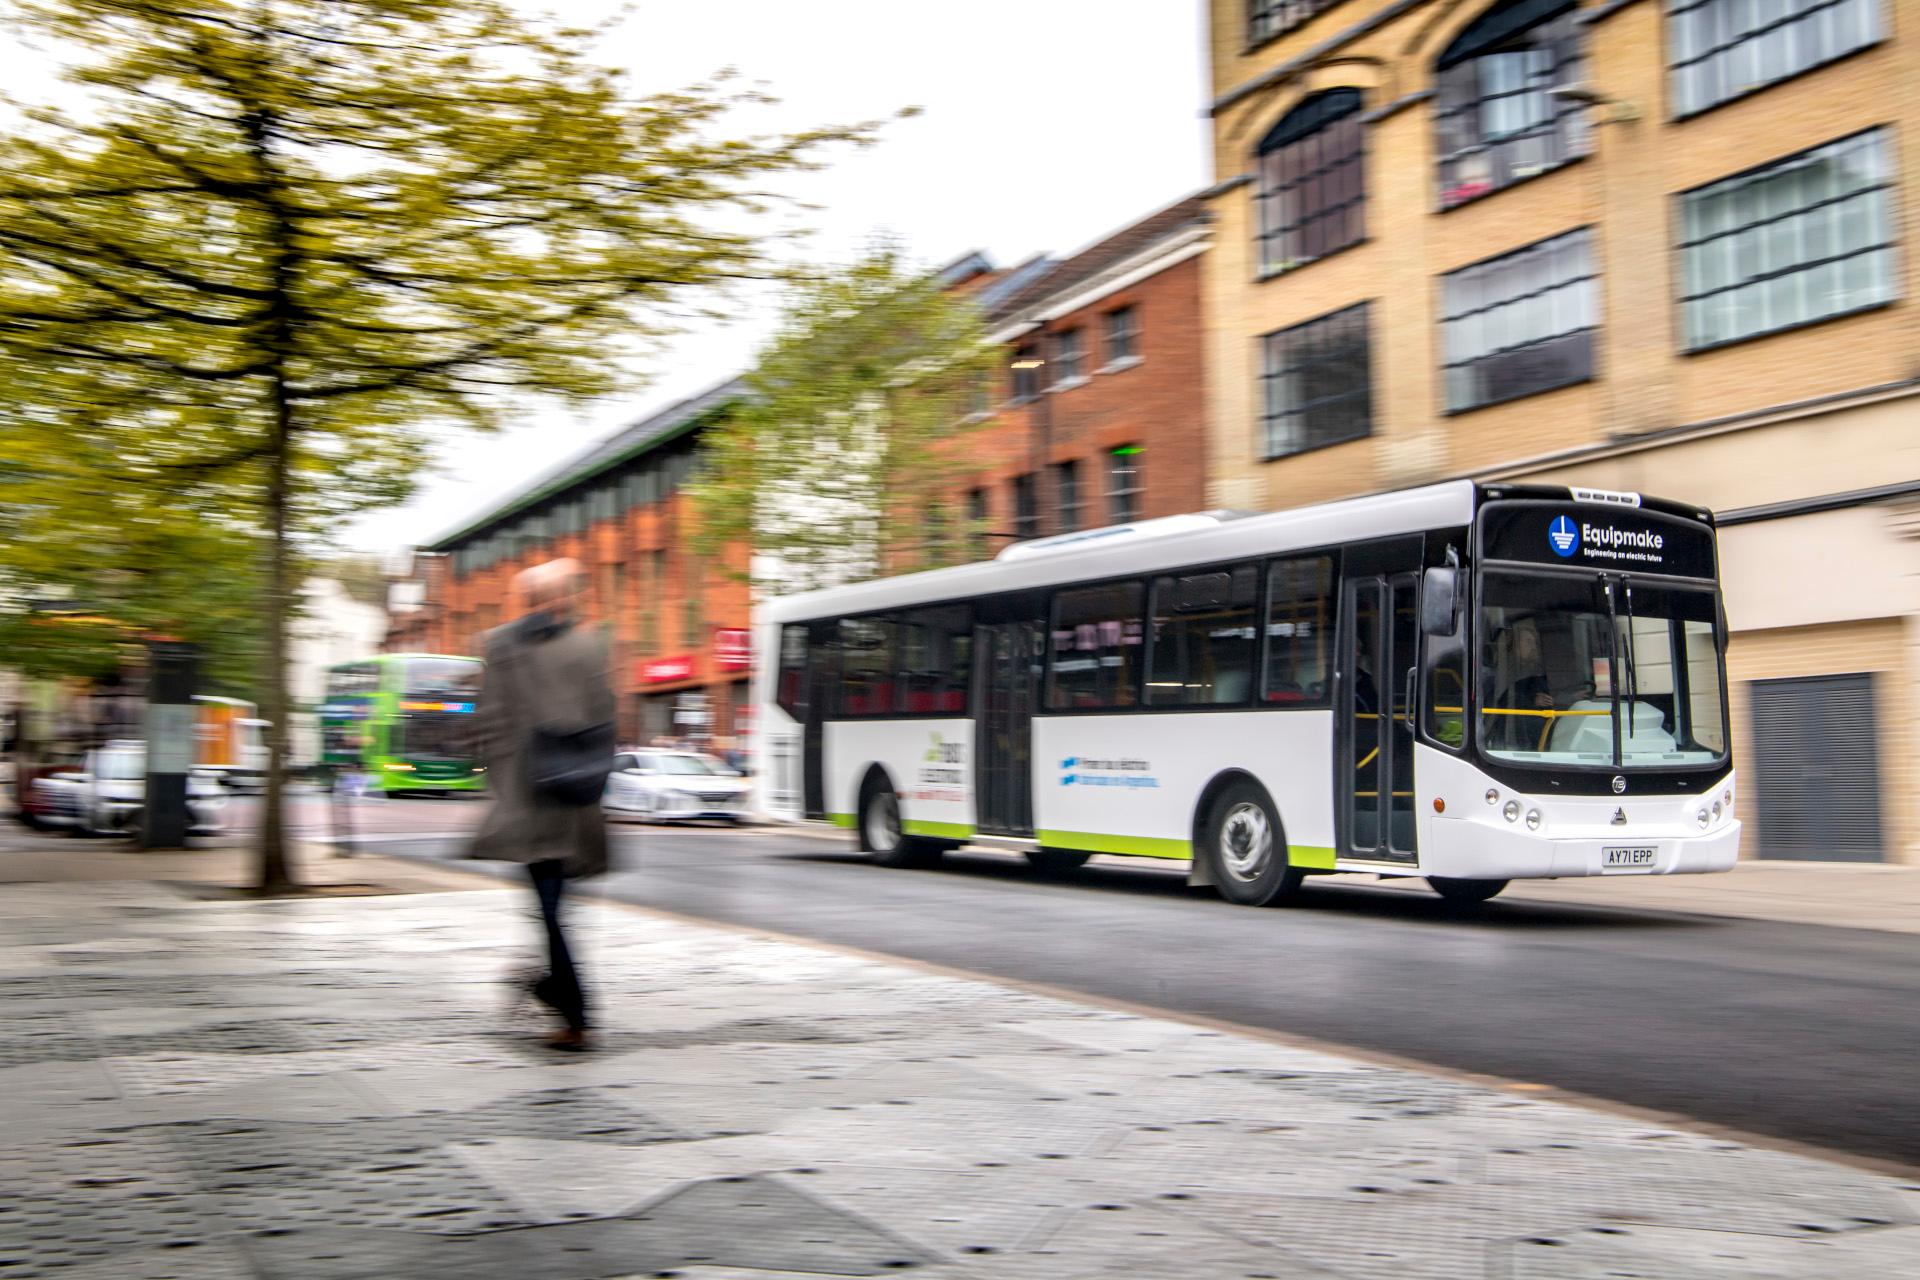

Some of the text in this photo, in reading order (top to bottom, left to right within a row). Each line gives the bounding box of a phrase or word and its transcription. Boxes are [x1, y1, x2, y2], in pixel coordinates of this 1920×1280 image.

[1583, 523, 1663, 549] Equipmake
[1584, 548, 1617, 559] Engineering
[1626, 552, 1646, 561] electric
[1647, 554, 1662, 562] future
[1609, 850, 1653, 863] AY71 EPP
